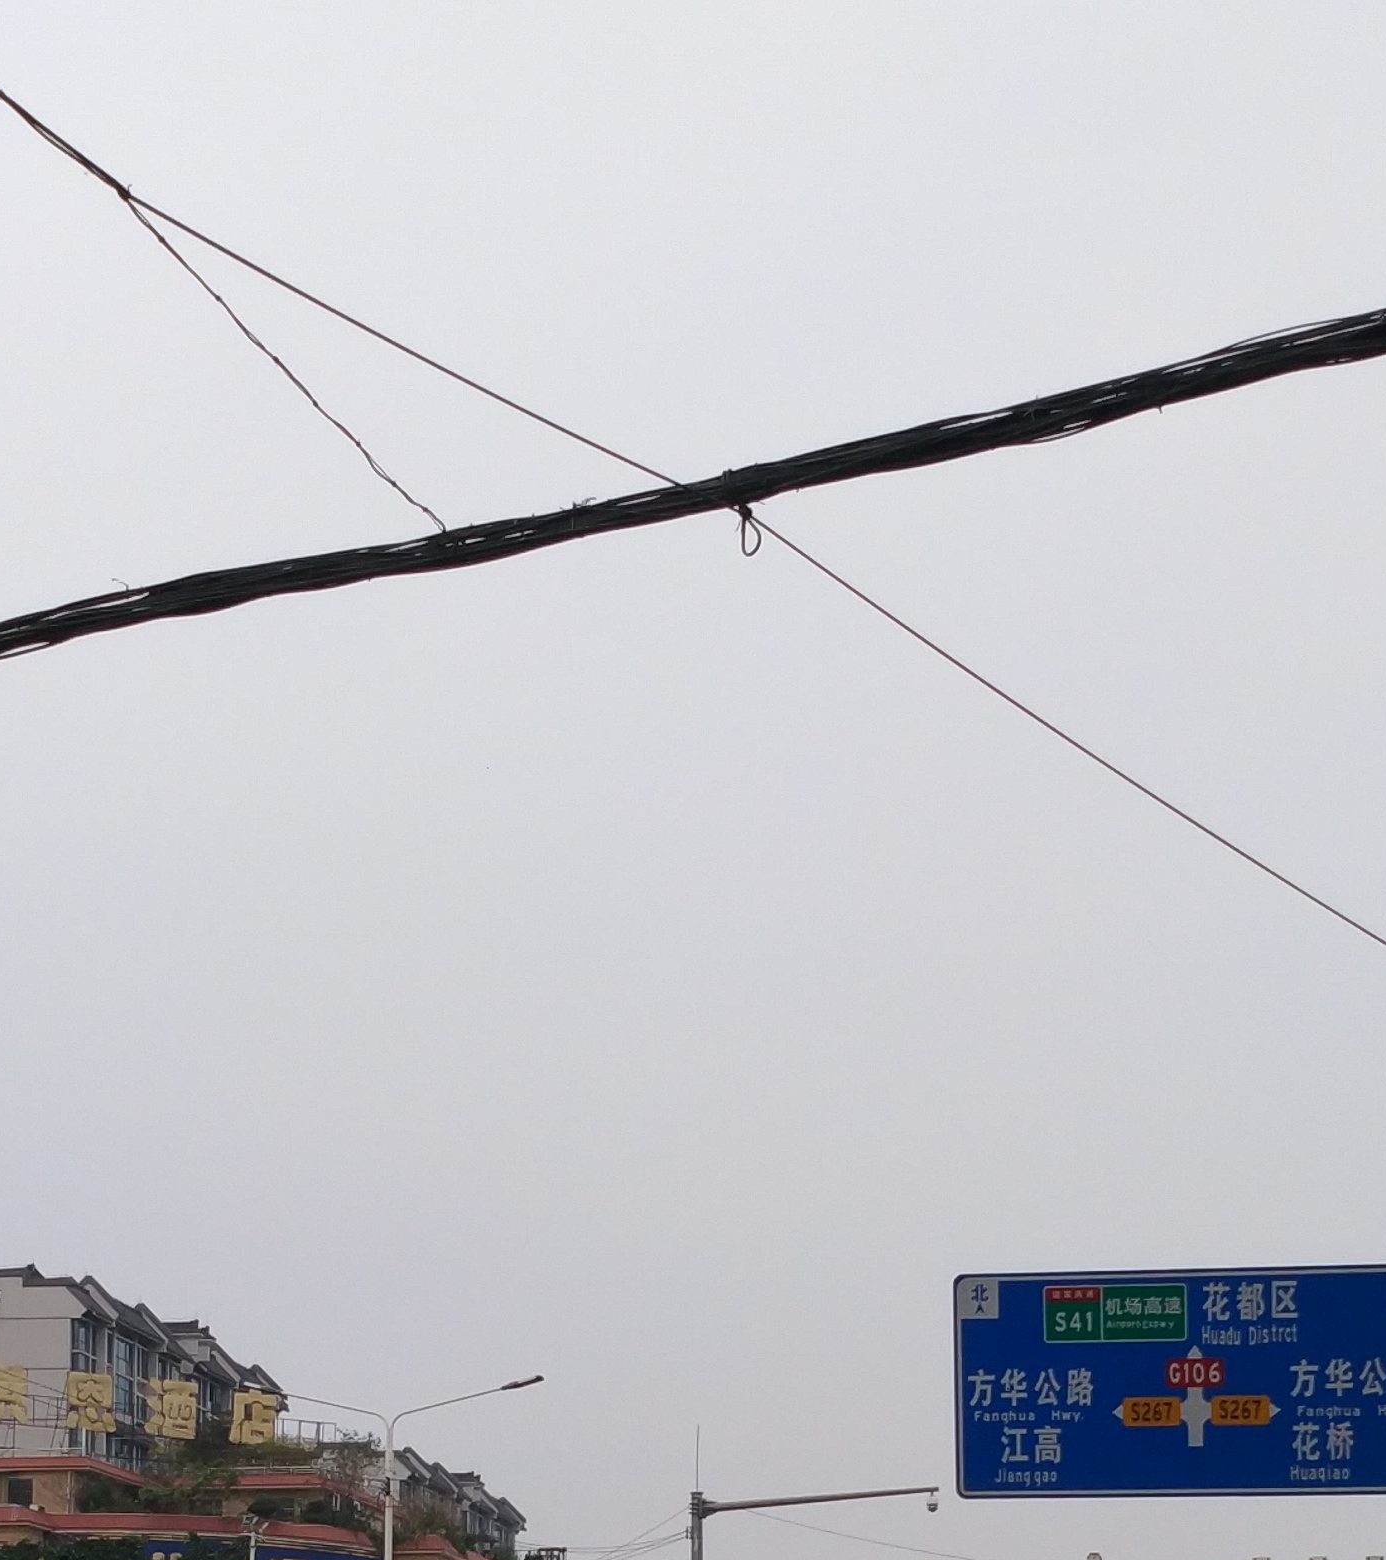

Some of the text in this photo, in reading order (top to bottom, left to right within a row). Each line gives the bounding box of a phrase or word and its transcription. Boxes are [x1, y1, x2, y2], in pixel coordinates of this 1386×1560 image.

[1105, 1296, 1183, 1316] 机场高速
[1202, 1280, 1300, 1321] 花都区
[1054, 1310, 1094, 1333] S41
[1201, 1325, 1241, 1345] Huadu
[1168, 1361, 1223, 1384] G106
[967, 1367, 1094, 1407] 方华公路
[974, 1409, 1036, 1426] Fanghua
[1129, 1402, 1174, 1423] S267
[1218, 1399, 1263, 1420] S267
[1296, 1403, 1361, 1421] Fanghua
[1000, 1425, 1062, 1464] 江高
[1292, 1421, 1355, 1461] 花桥
[994, 1467, 1058, 1485] Jianggao
[1289, 1464, 1351, 1482] Huaqiao
